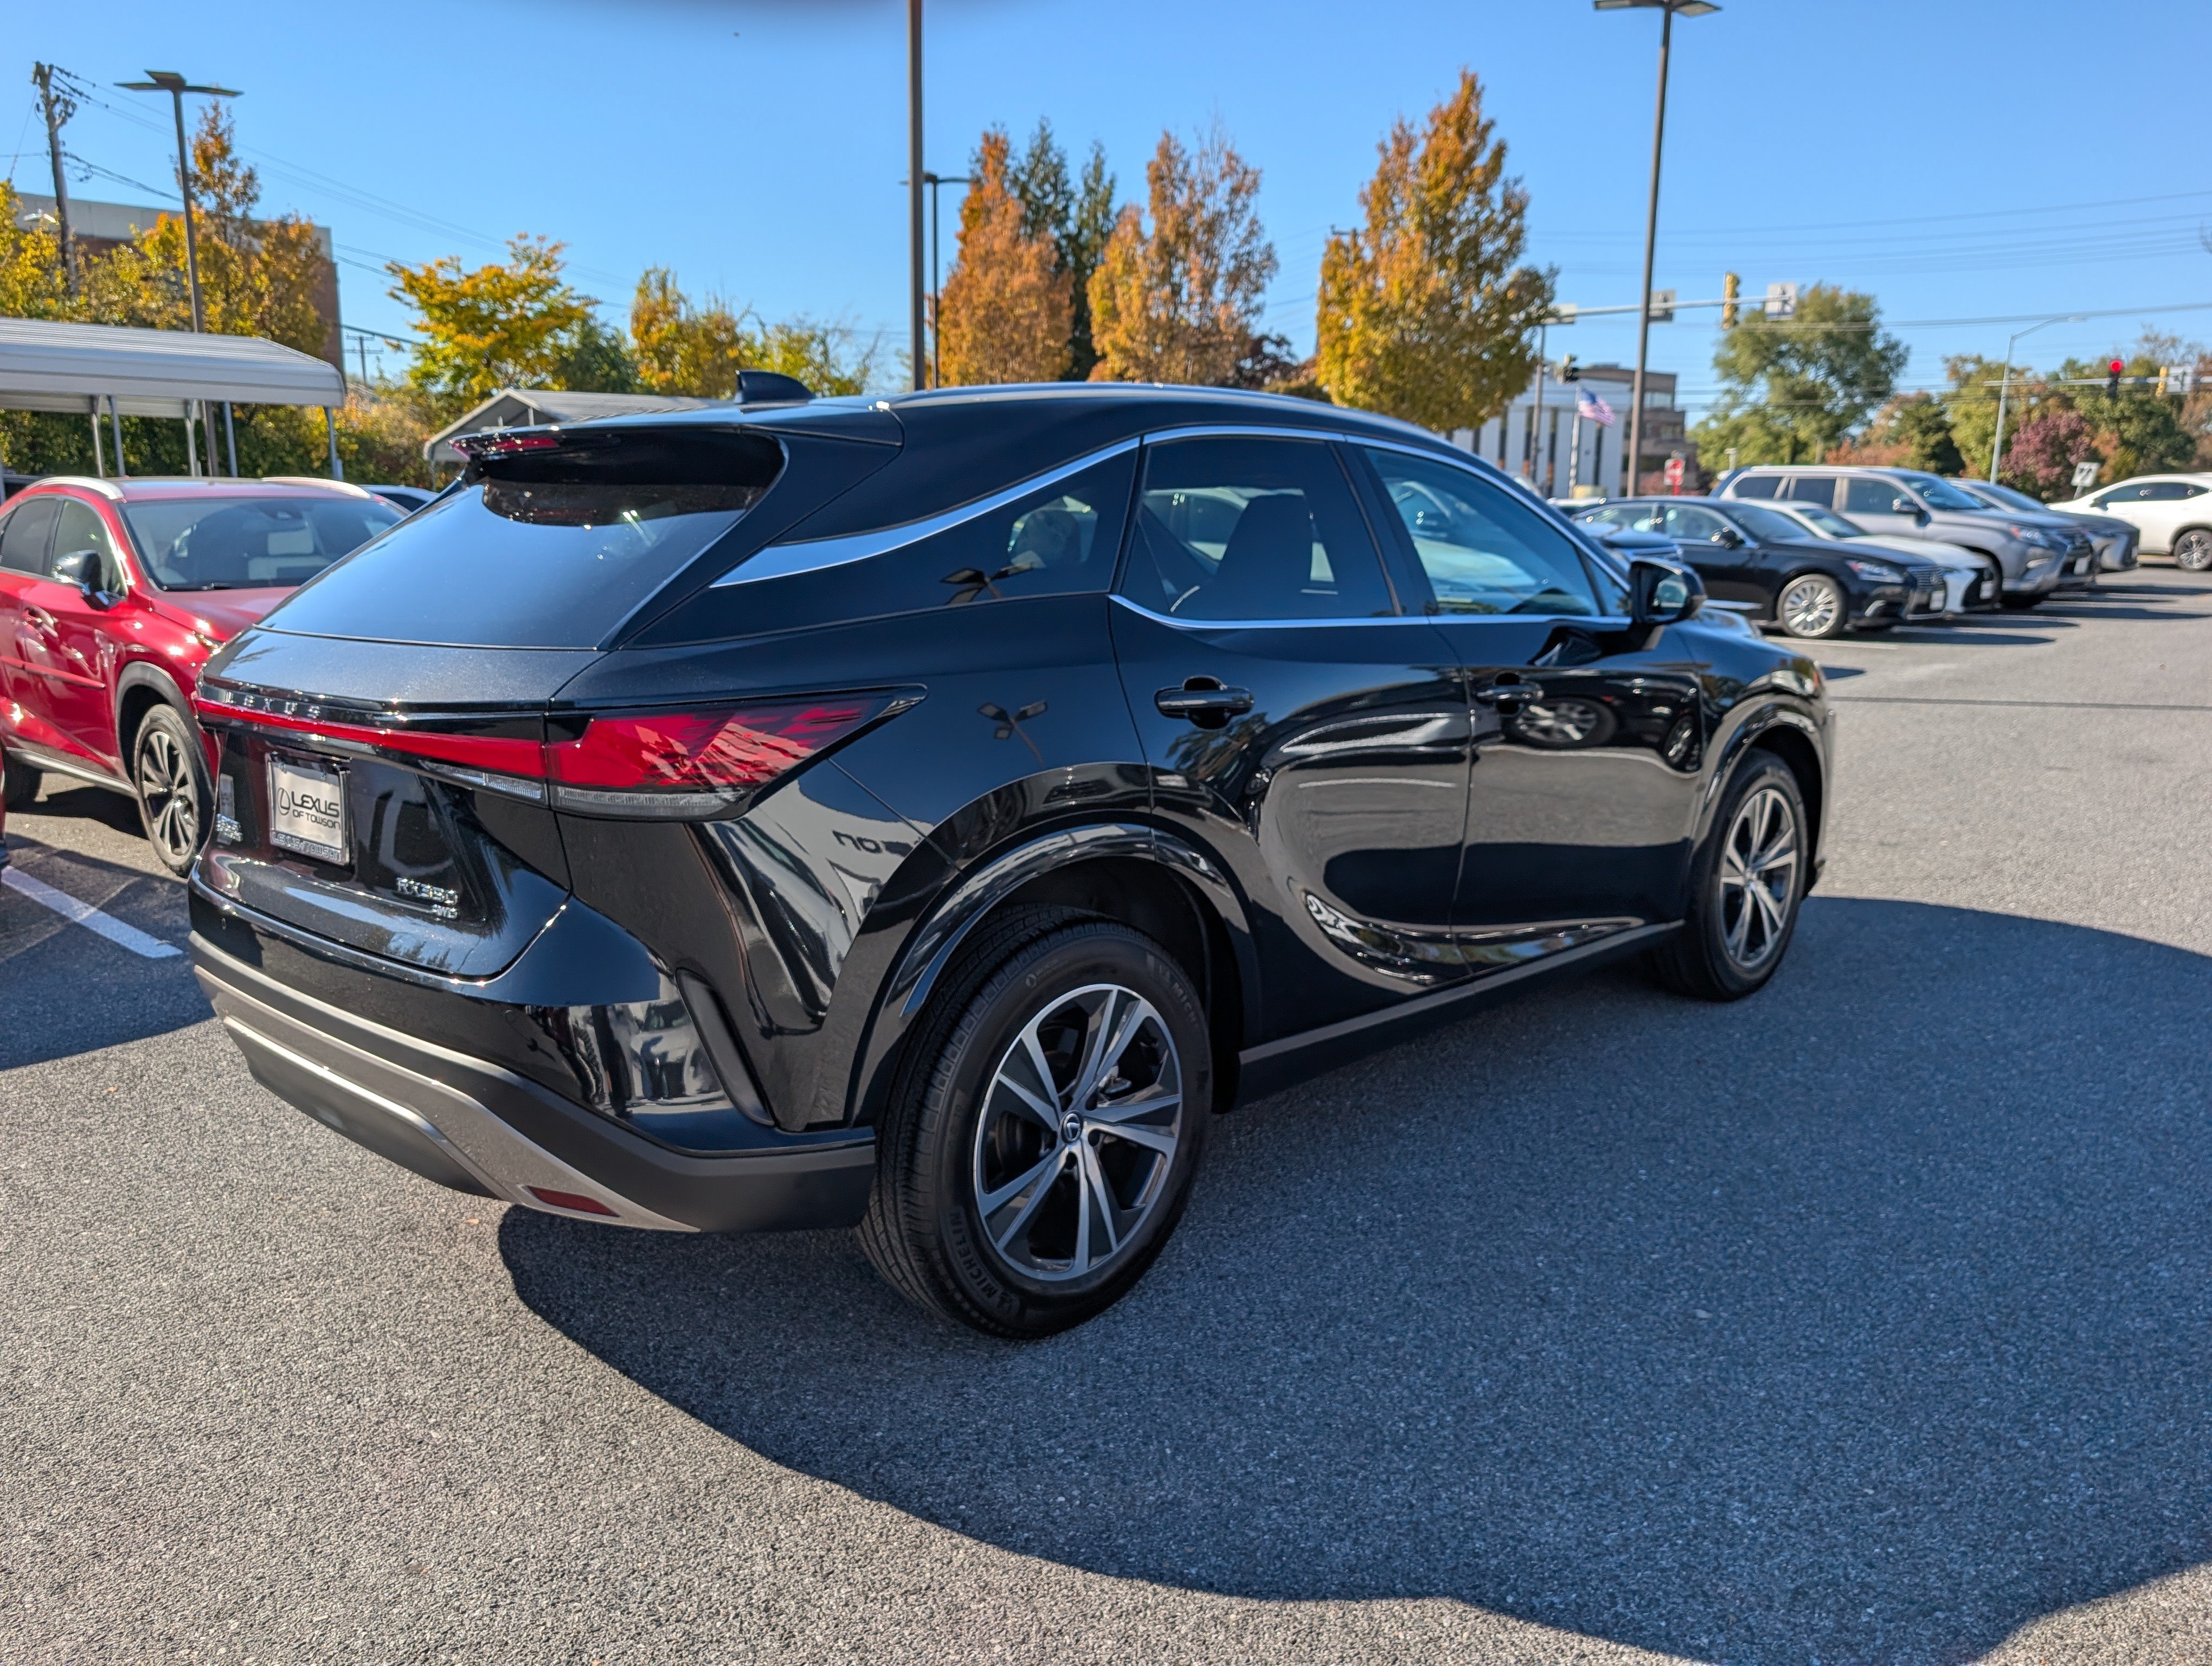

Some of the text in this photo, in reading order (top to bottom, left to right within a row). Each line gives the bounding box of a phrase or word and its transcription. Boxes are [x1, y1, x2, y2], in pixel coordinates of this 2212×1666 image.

[225, 690, 320, 719] LEXUS
[291, 791, 339, 818] LEXUS
[292, 809, 304, 818] OF
